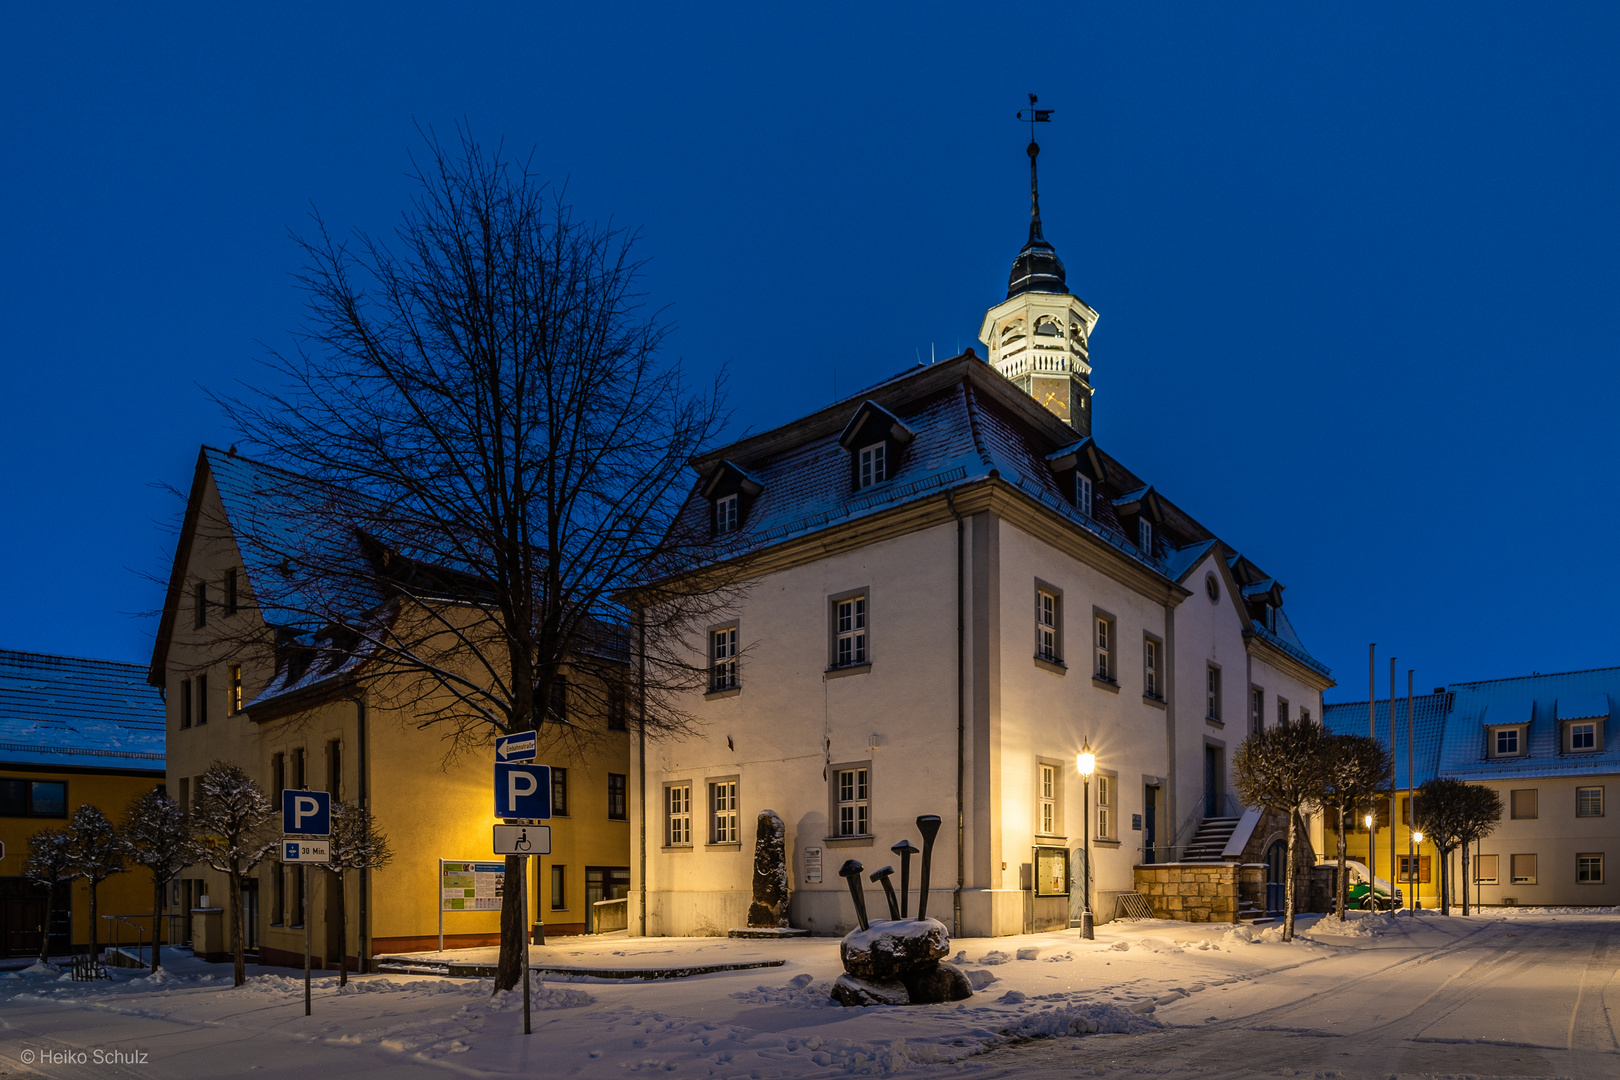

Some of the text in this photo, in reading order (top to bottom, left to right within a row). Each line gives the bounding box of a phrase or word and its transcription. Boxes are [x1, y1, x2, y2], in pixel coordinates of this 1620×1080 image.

[508, 770, 538, 812] P
[294, 796, 319, 829] P
[301, 847, 327, 855] 30 Min.
